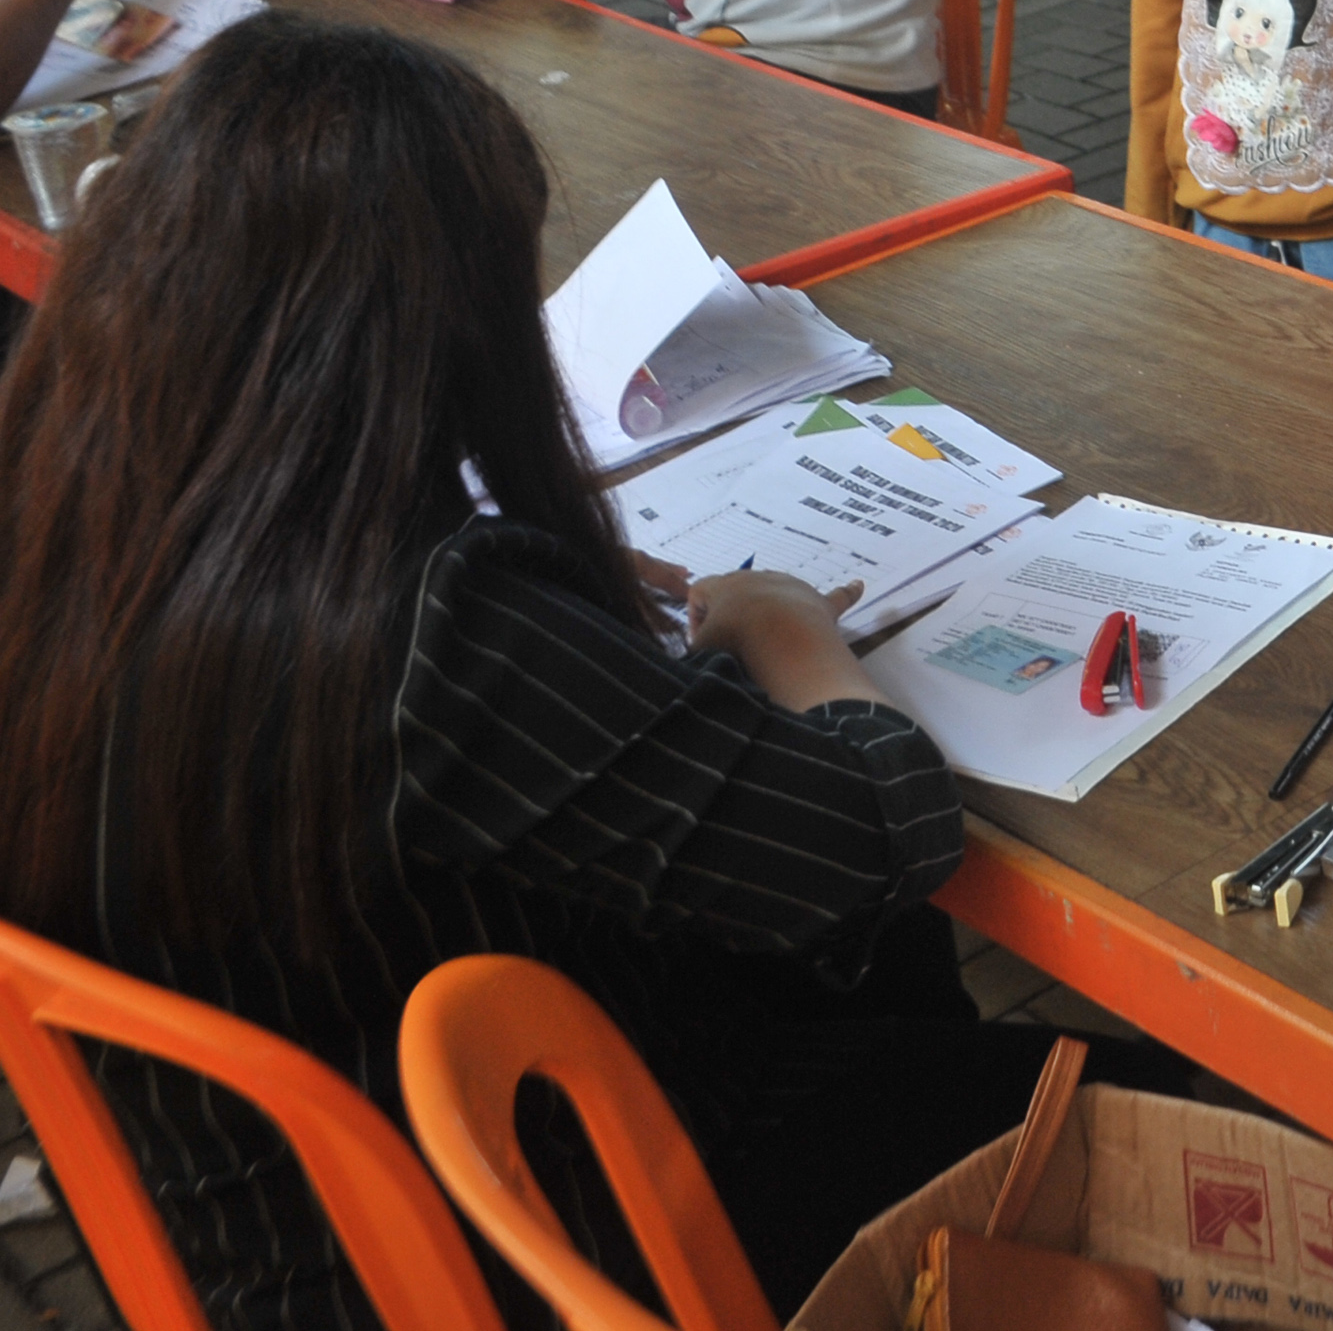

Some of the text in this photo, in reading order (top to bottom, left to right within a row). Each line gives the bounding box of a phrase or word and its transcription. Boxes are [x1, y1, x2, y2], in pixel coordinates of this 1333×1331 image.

[1234, 115, 1311, 174] ashion
[796, 454, 843, 484] BANTUAN
[840, 479, 876, 499] SOSIAL
[850, 465, 891, 489] DAFTAR
